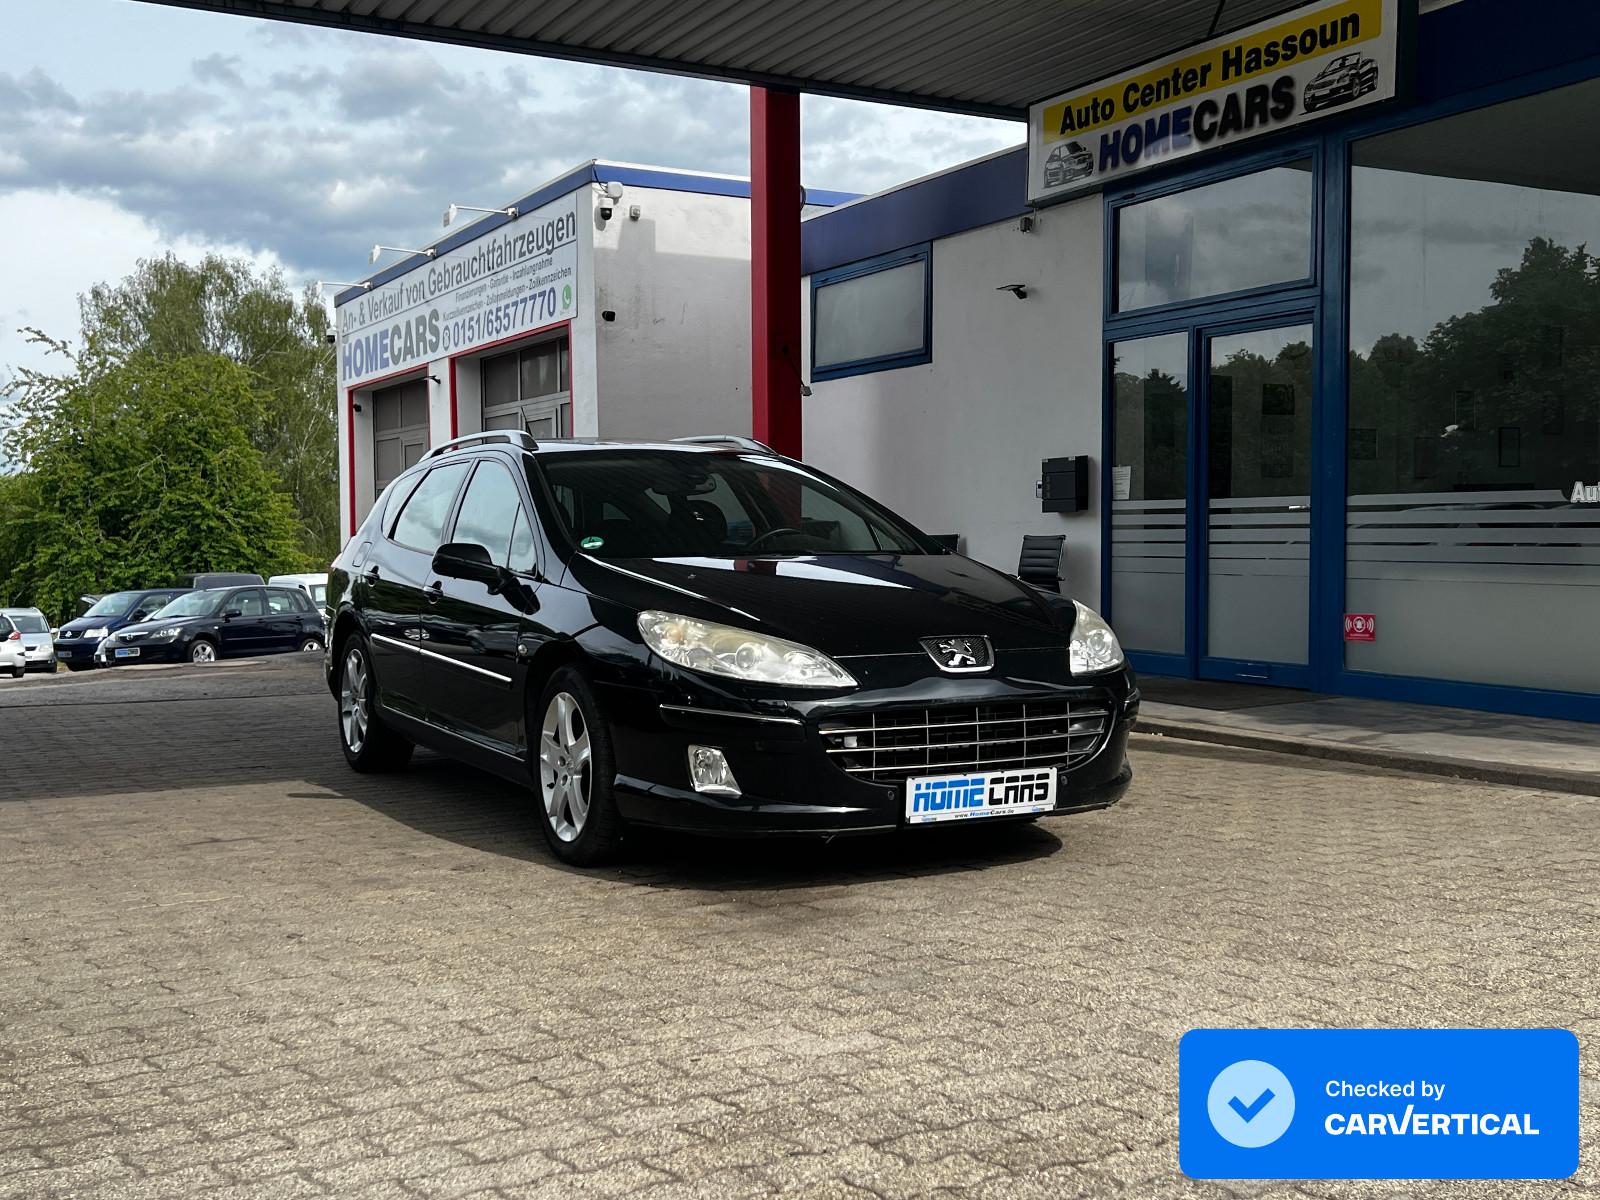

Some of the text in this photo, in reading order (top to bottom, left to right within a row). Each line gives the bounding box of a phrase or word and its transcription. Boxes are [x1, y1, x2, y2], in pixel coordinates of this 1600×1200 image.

[1060, 11, 1360, 134] Auto Center Hassoun
[1098, 75, 1295, 172] HOMECARS
[342, 210, 576, 333] An- & Verkauf von Gebrauchtfahrzeugen
[342, 308, 440, 381] HOMECARS
[453, 287, 556, 348] 0151/65577770
[1570, 481, 1600, 503] Au
[913, 773, 1050, 813] HOME CARS
